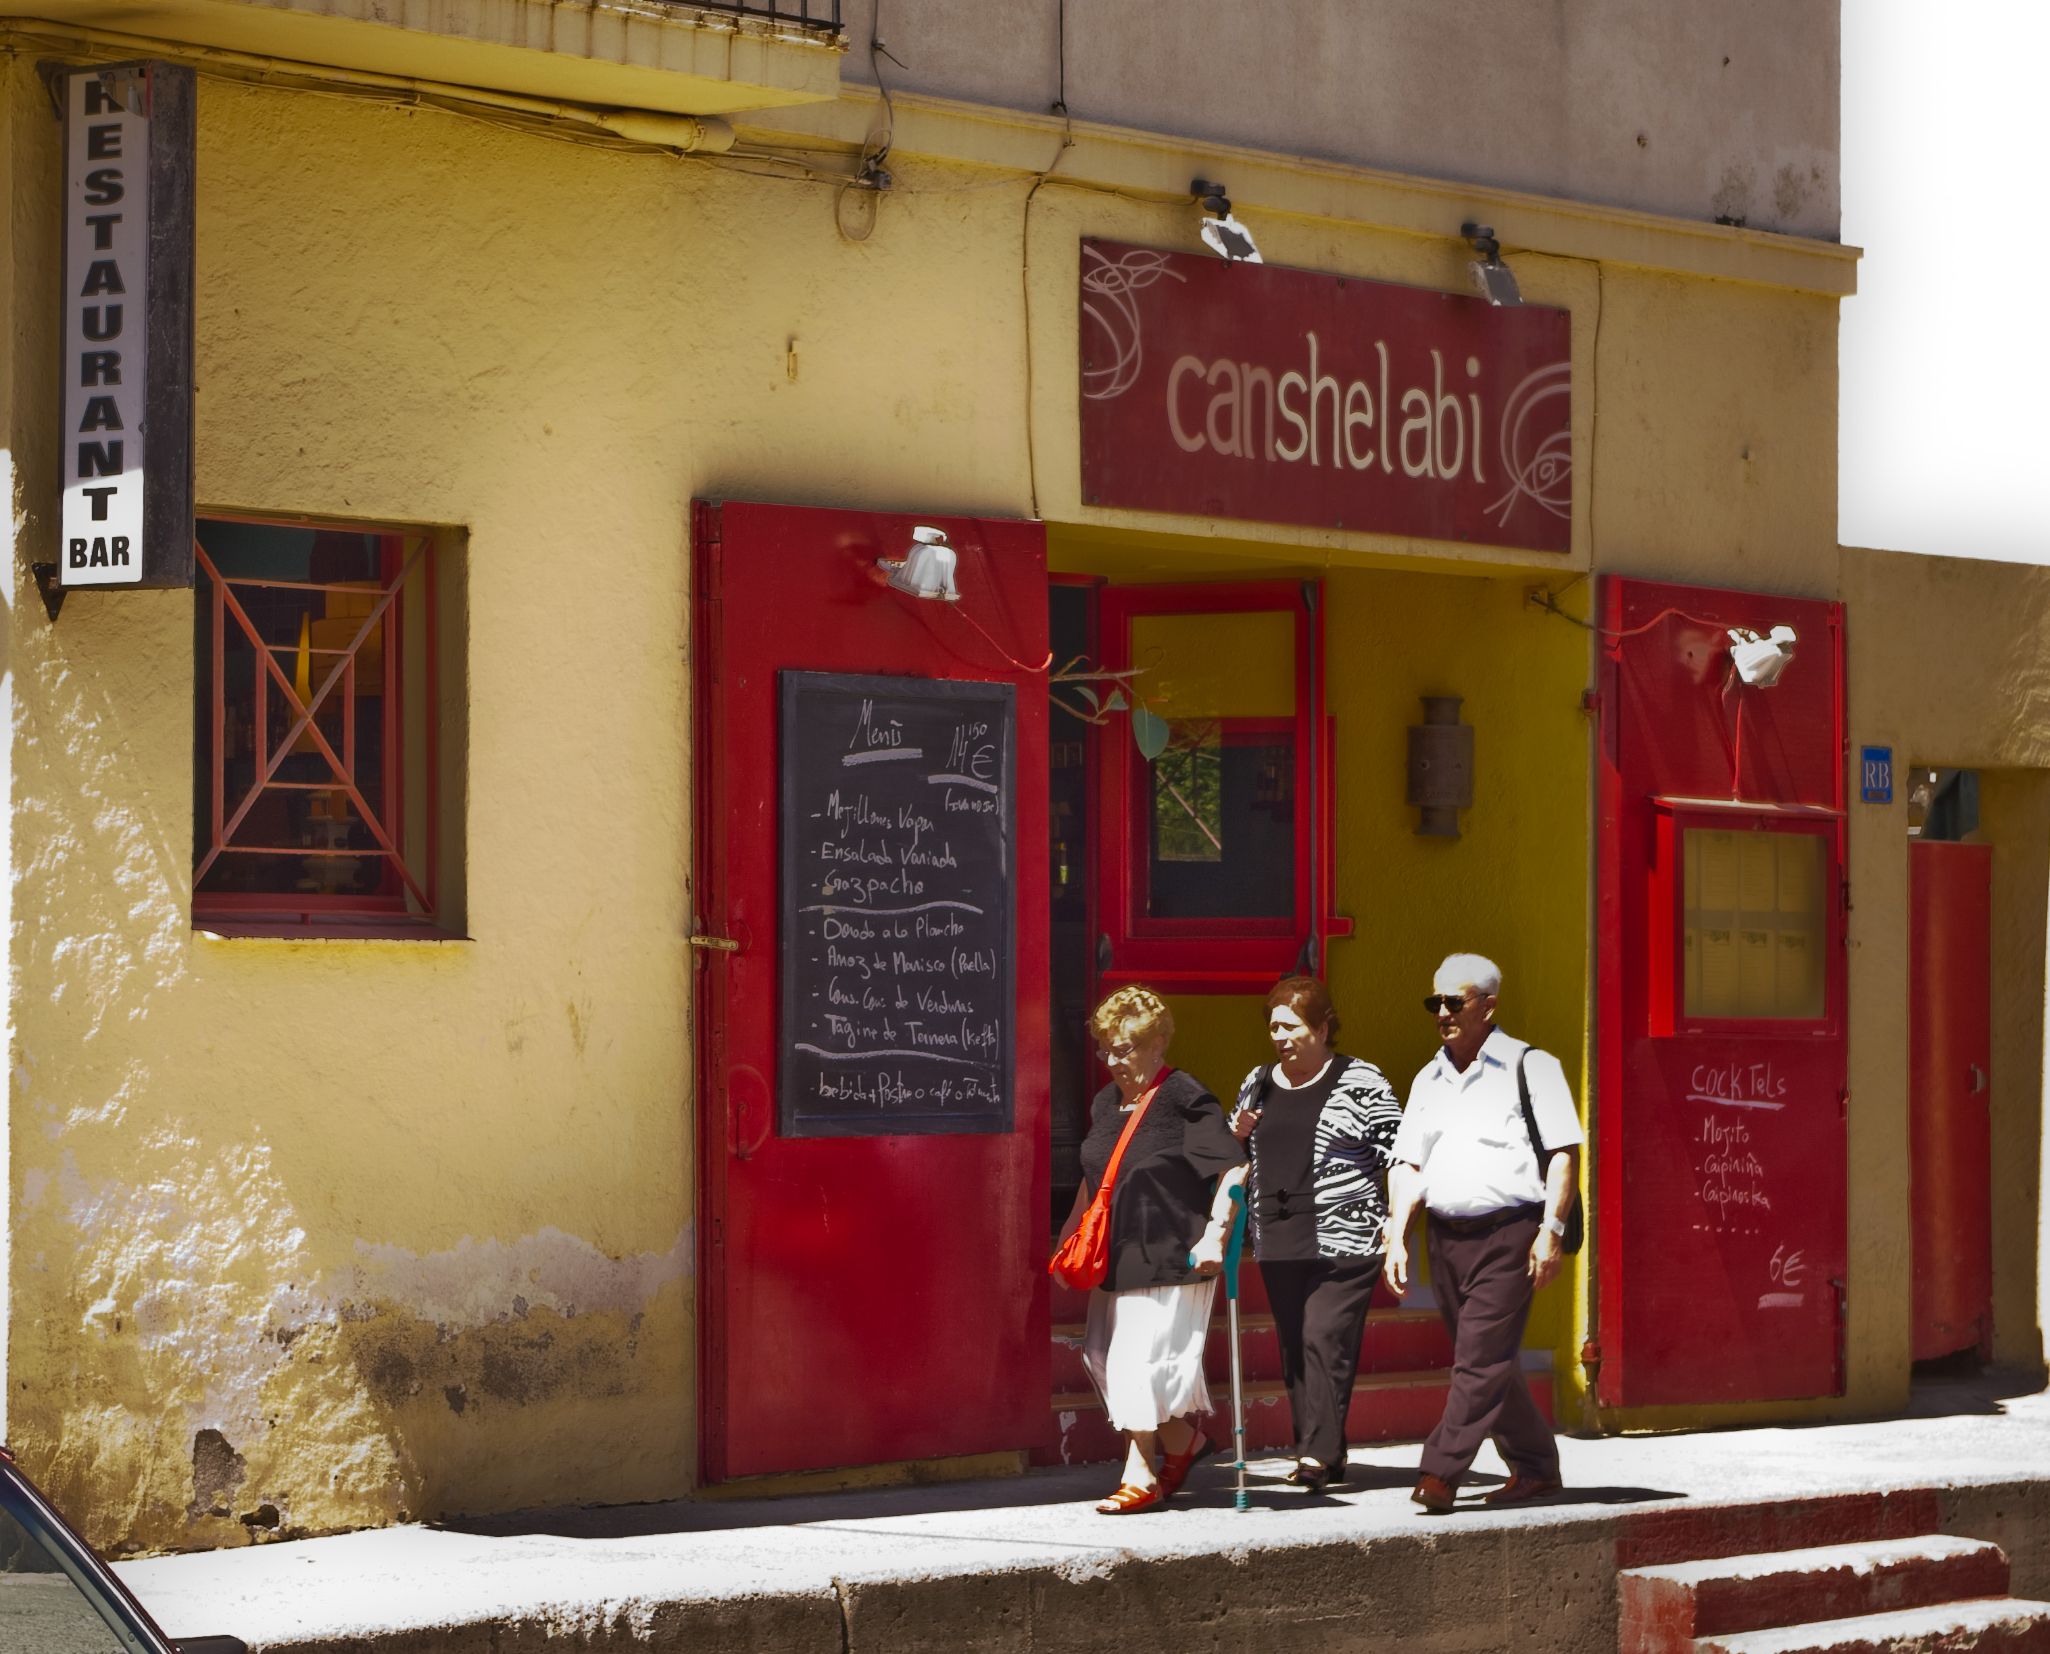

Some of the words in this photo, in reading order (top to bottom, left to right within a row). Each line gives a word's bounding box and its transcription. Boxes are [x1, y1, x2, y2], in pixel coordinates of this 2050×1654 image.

[69, 535, 130, 569] BAR
[1865, 761, 1890, 789] RB
[821, 838, 893, 866] Ensalada
[900, 841, 958, 869] Variada
[824, 868, 925, 905] Gazpacho
[873, 952, 887, 971] de
[893, 951, 946, 976] Marisco
[916, 985, 974, 1014] Verduras
[883, 1017, 897, 1042] de
[904, 1020, 959, 1046] Ternera
[1703, 1114, 1750, 1158] Mojito
